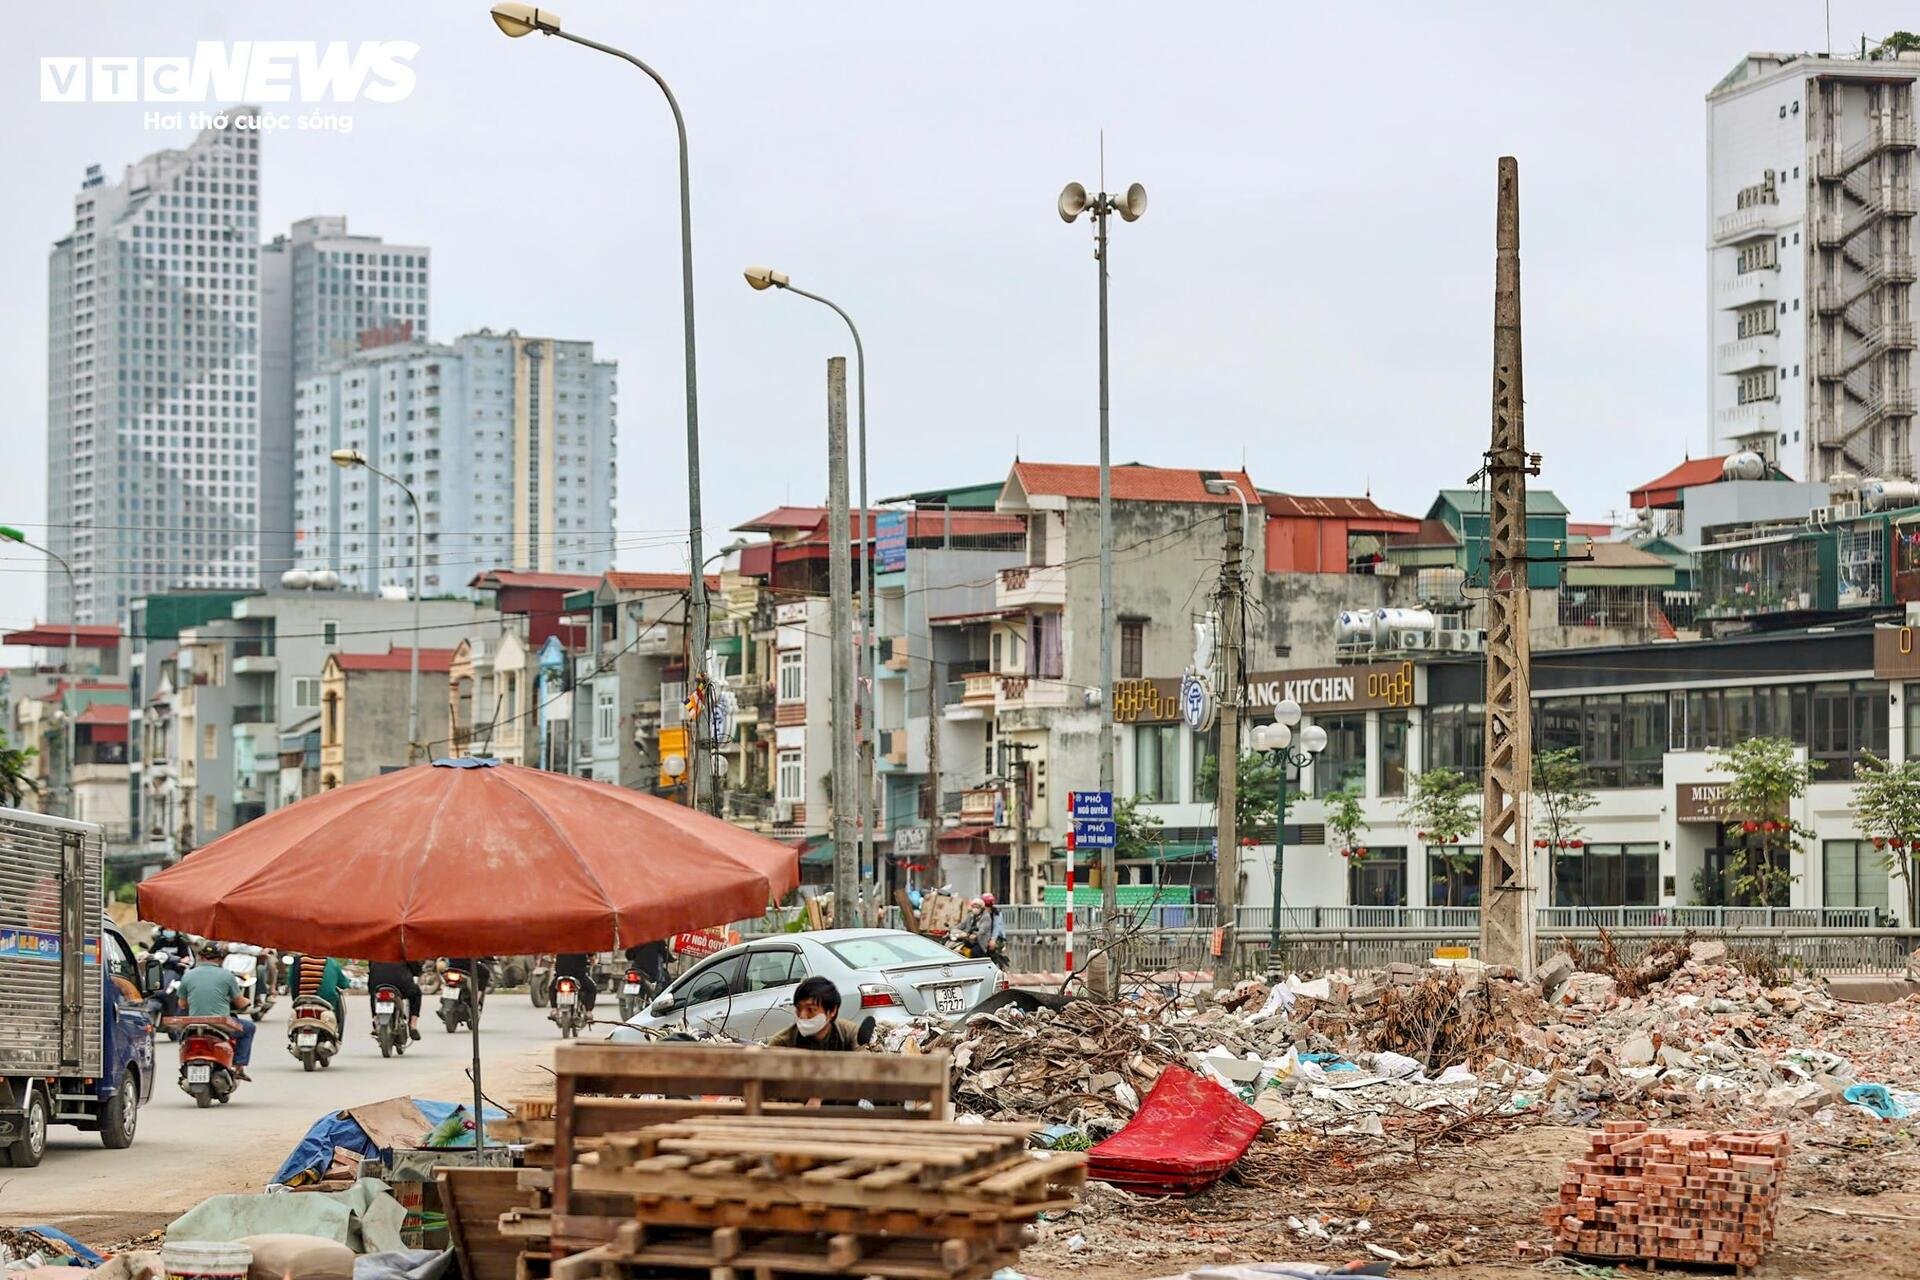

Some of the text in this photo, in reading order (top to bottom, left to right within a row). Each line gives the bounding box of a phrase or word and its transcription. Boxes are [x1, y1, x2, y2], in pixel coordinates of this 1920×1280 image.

[1284, 676, 1354, 704] KITCHEN
[942, 988, 957, 999] 30E
[939, 999, 963, 1011] 57277
